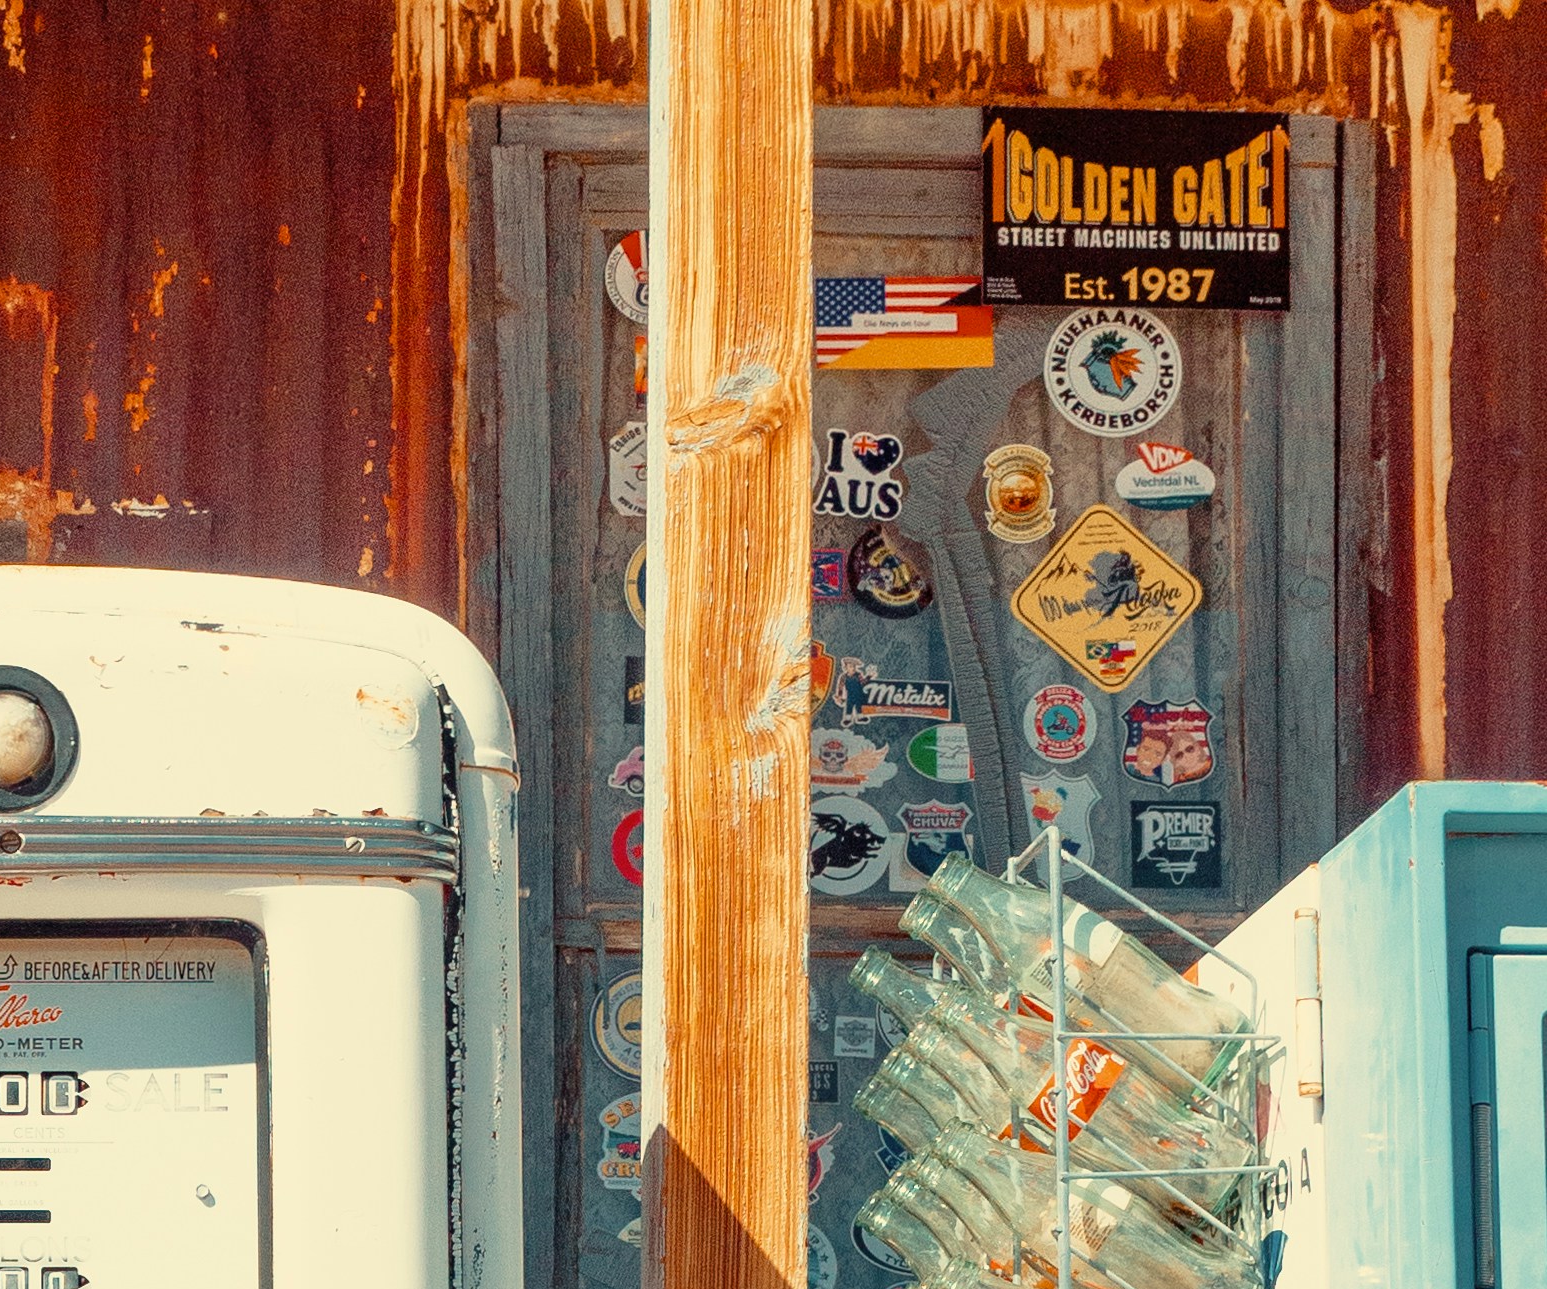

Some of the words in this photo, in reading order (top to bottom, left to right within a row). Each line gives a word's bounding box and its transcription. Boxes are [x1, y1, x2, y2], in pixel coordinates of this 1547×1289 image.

[1007, 129, 1157, 226] GOLDEN
[1173, 130, 1272, 228] GATE
[997, 227, 1067, 248] STREET
[1073, 228, 1171, 250] MACHINES
[1179, 230, 1281, 252] UNLIMITED
[1064, 271, 1116, 300] Est.
[1122, 265, 1215, 302] 1987
[1051, 308, 1166, 373] NEUEHAANER
[1058, 364, 1174, 428] KERBEBORSCH
[828, 431, 847, 473] I
[815, 475, 901, 519] AUS
[1133, 476, 1182, 488] Vechtdal
[1184, 475, 1200, 486] NL
[863, 682, 946, 706] Métalix
[913, 818, 956, 829] CHUVA
[1135, 810, 1216, 863] PREMIER
[146, 960, 216, 980] DELIVERY
[104, 1072, 229, 1113] SALE
[13, 1127, 66, 1139] CENTS
[604, 1100, 642, 1129] SE
